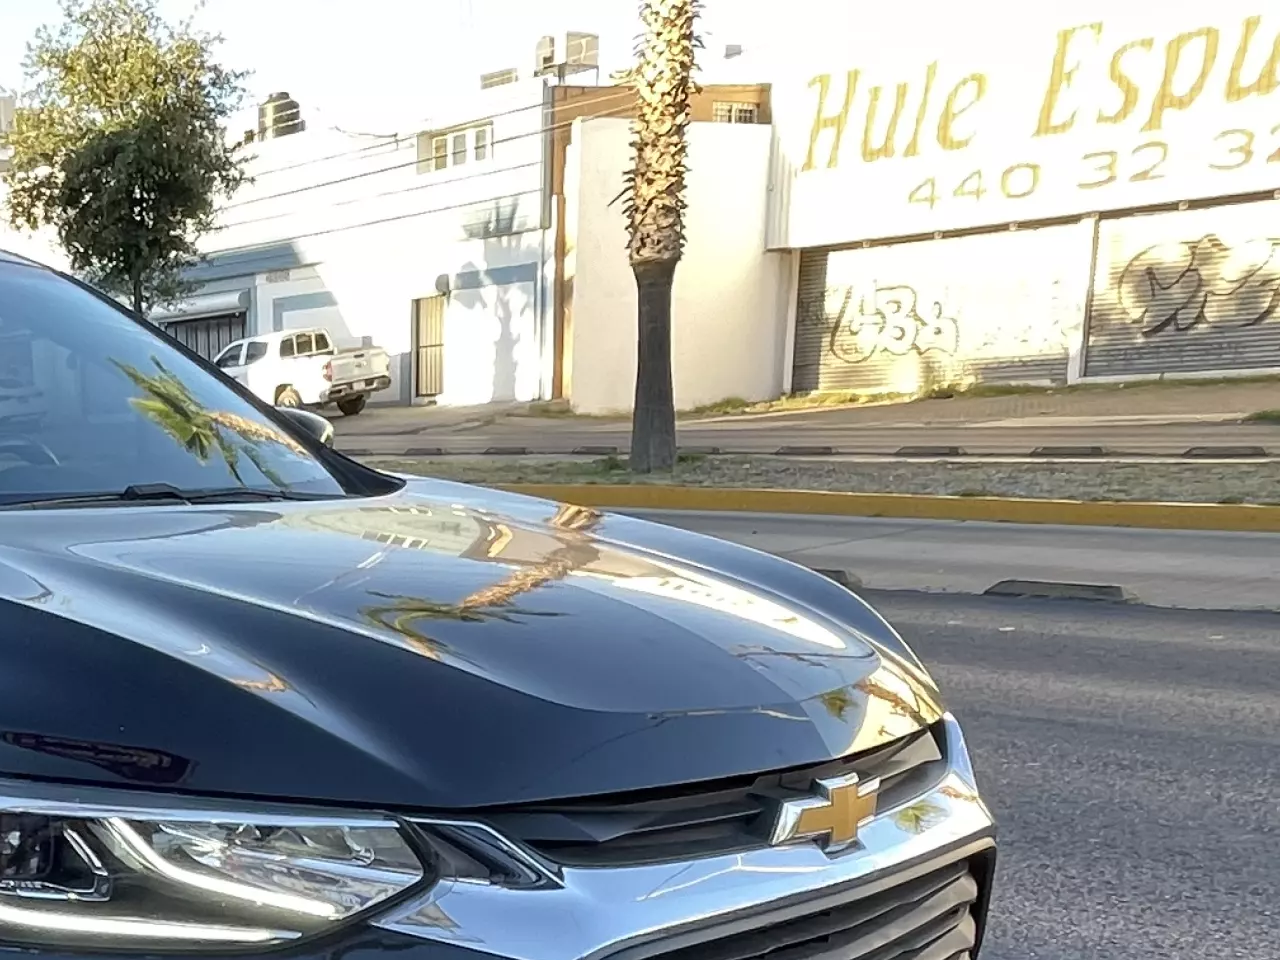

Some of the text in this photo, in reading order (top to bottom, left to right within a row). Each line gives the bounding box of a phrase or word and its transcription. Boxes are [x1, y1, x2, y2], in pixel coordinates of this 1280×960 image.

[798, 60, 988, 173] Hule
[907, 162, 1041, 210] 440
[1077, 140, 1169, 190] 32
